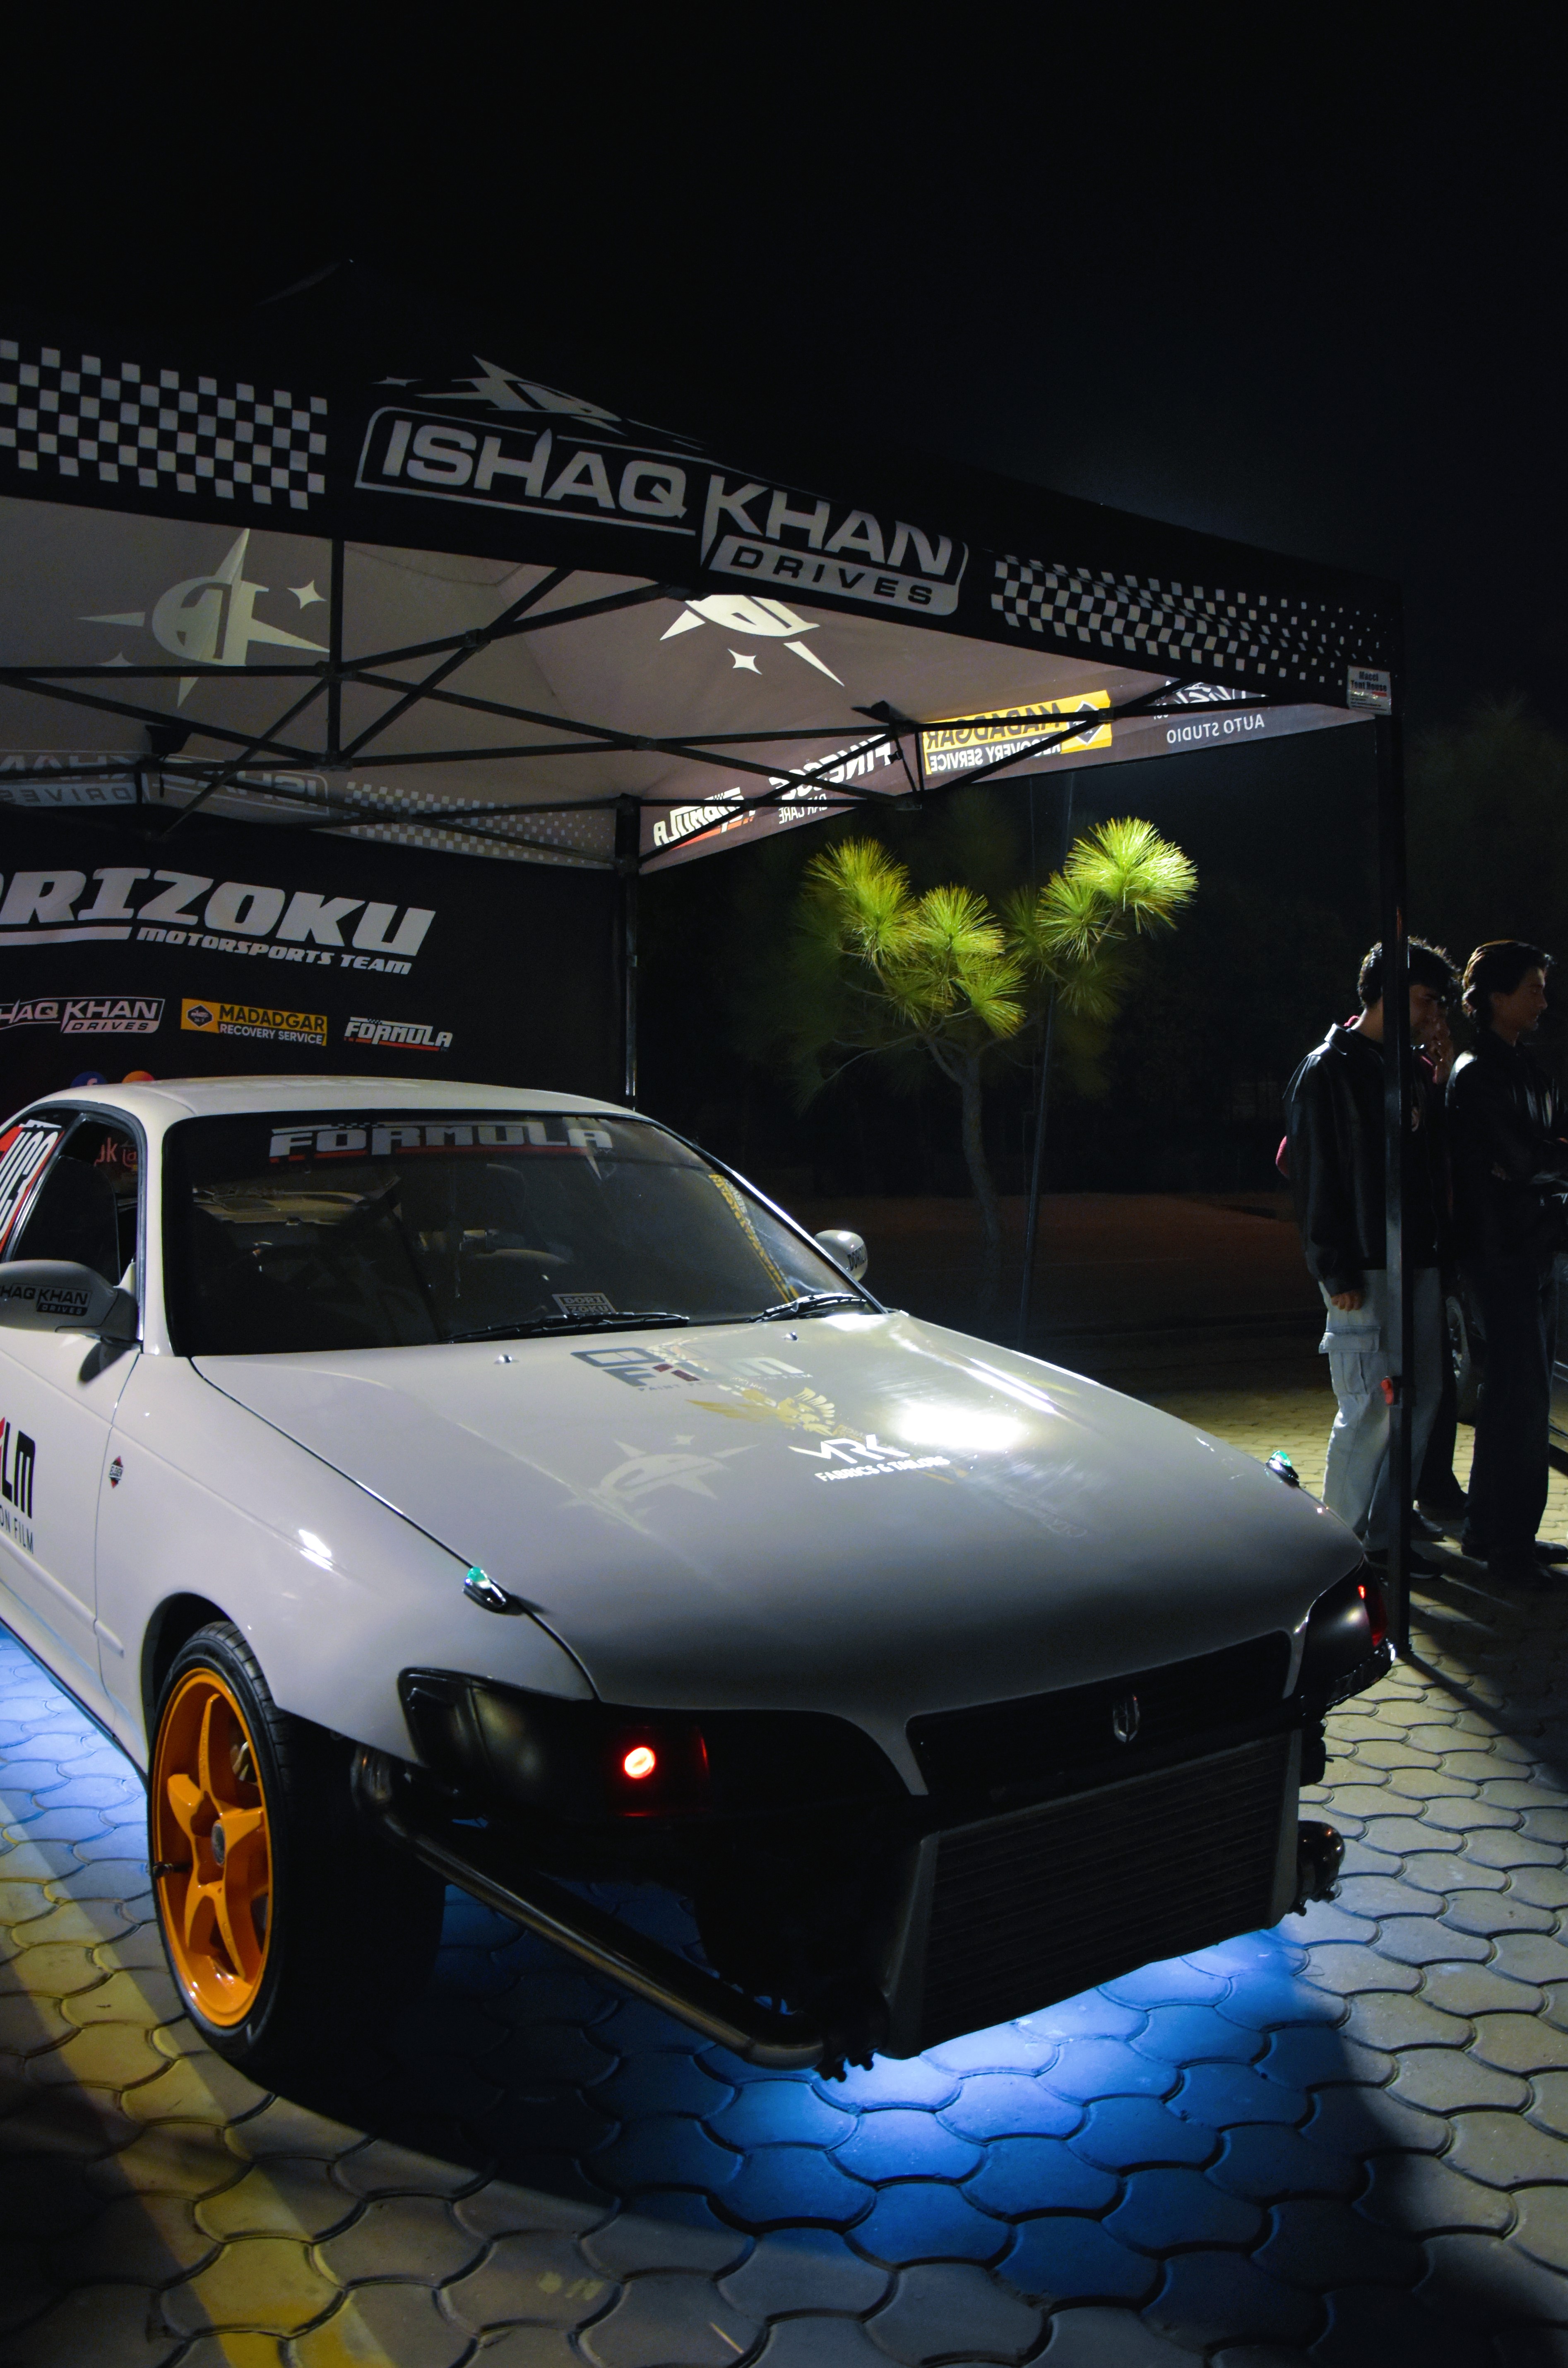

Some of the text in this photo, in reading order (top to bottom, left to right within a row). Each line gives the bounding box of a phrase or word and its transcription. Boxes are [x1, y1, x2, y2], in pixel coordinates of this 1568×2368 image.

[381, 420, 952, 575] ISHAQ KHAN
[731, 545, 934, 606] DRIVES
[0, 867, 436, 956] RIZOKU
[137, 927, 412, 975] MOTORSPORTS TEAM
[60, 1000, 159, 1033] KHAN
[71, 1022, 149, 1031] DRIVES
[219, 1005, 325, 1031] MADADGAR
[220, 1023, 323, 1045] RECOVERY SERVICE
[344, 1017, 453, 1048] FORMULA
[269, 1121, 613, 1158] FORMULA
[0, 1285, 88, 1309] HAQ KHAN
[41, 1305, 83, 1315] DRIVES
[563, 1296, 604, 1304] DORI
[568, 1305, 610, 1313] ZOKU
[814, 1464, 880, 1482] FABRICS
[877, 1463, 894, 1473] &
[14, 1517, 34, 1554] FILM
